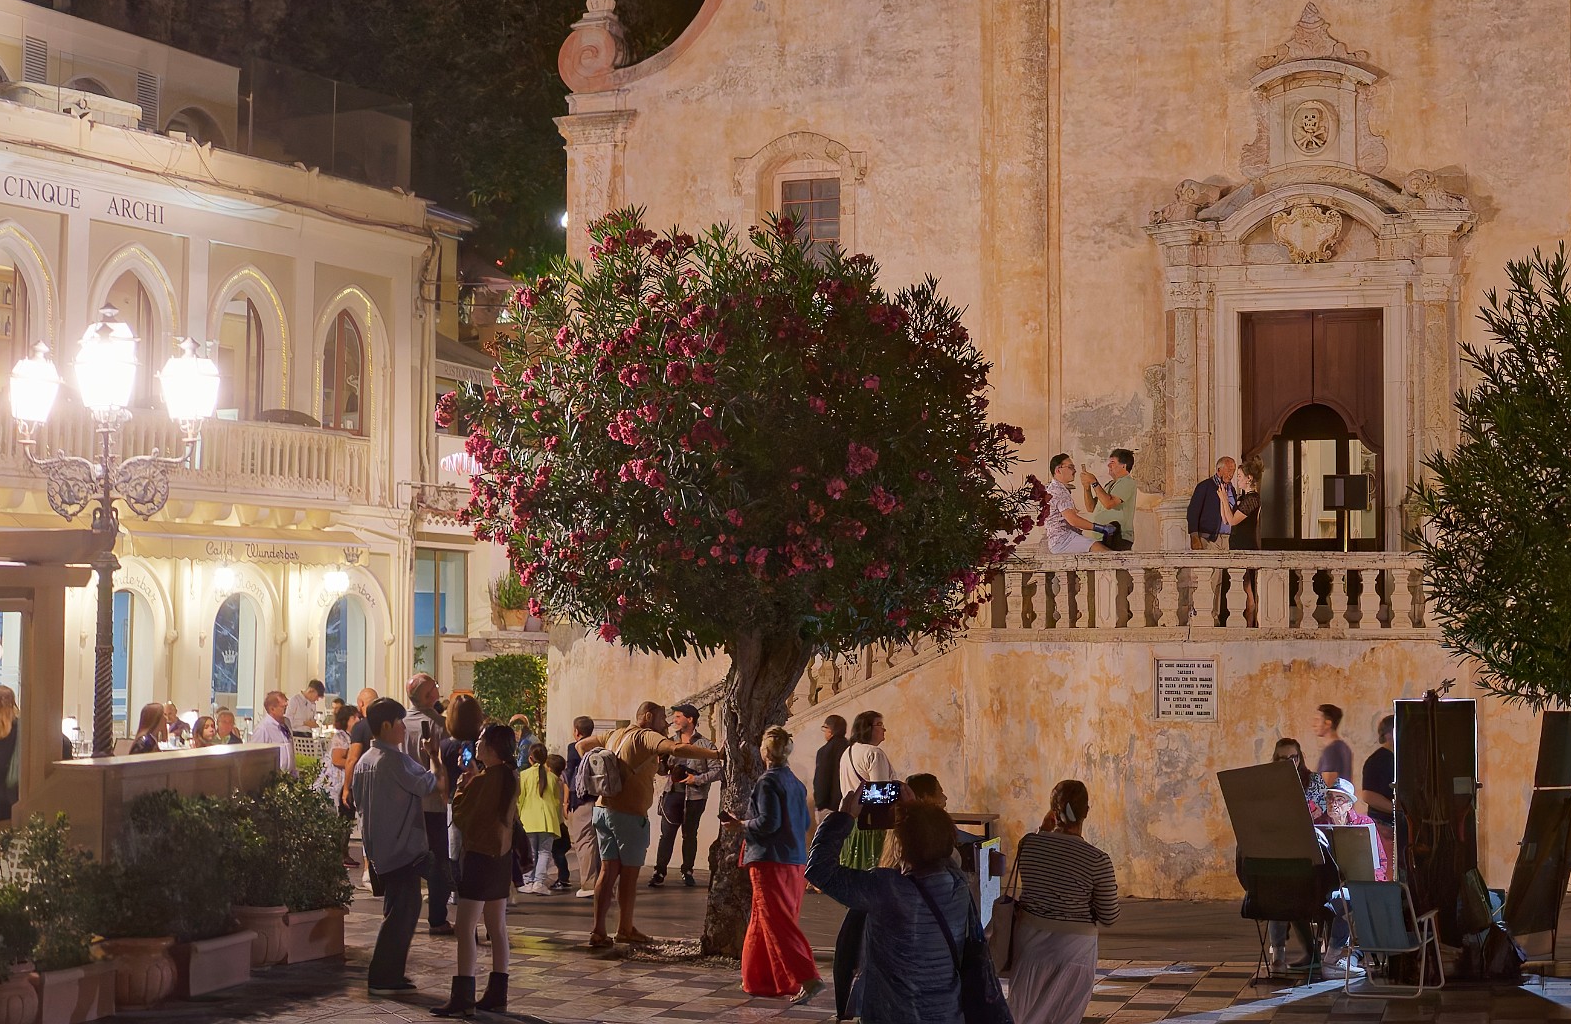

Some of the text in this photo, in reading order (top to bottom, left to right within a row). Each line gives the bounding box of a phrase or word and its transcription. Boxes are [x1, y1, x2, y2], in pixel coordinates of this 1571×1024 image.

[3, 175, 81, 210] CINQUE
[106, 196, 165, 225] ARCHI
[245, 542, 299, 560] Wunderbar
